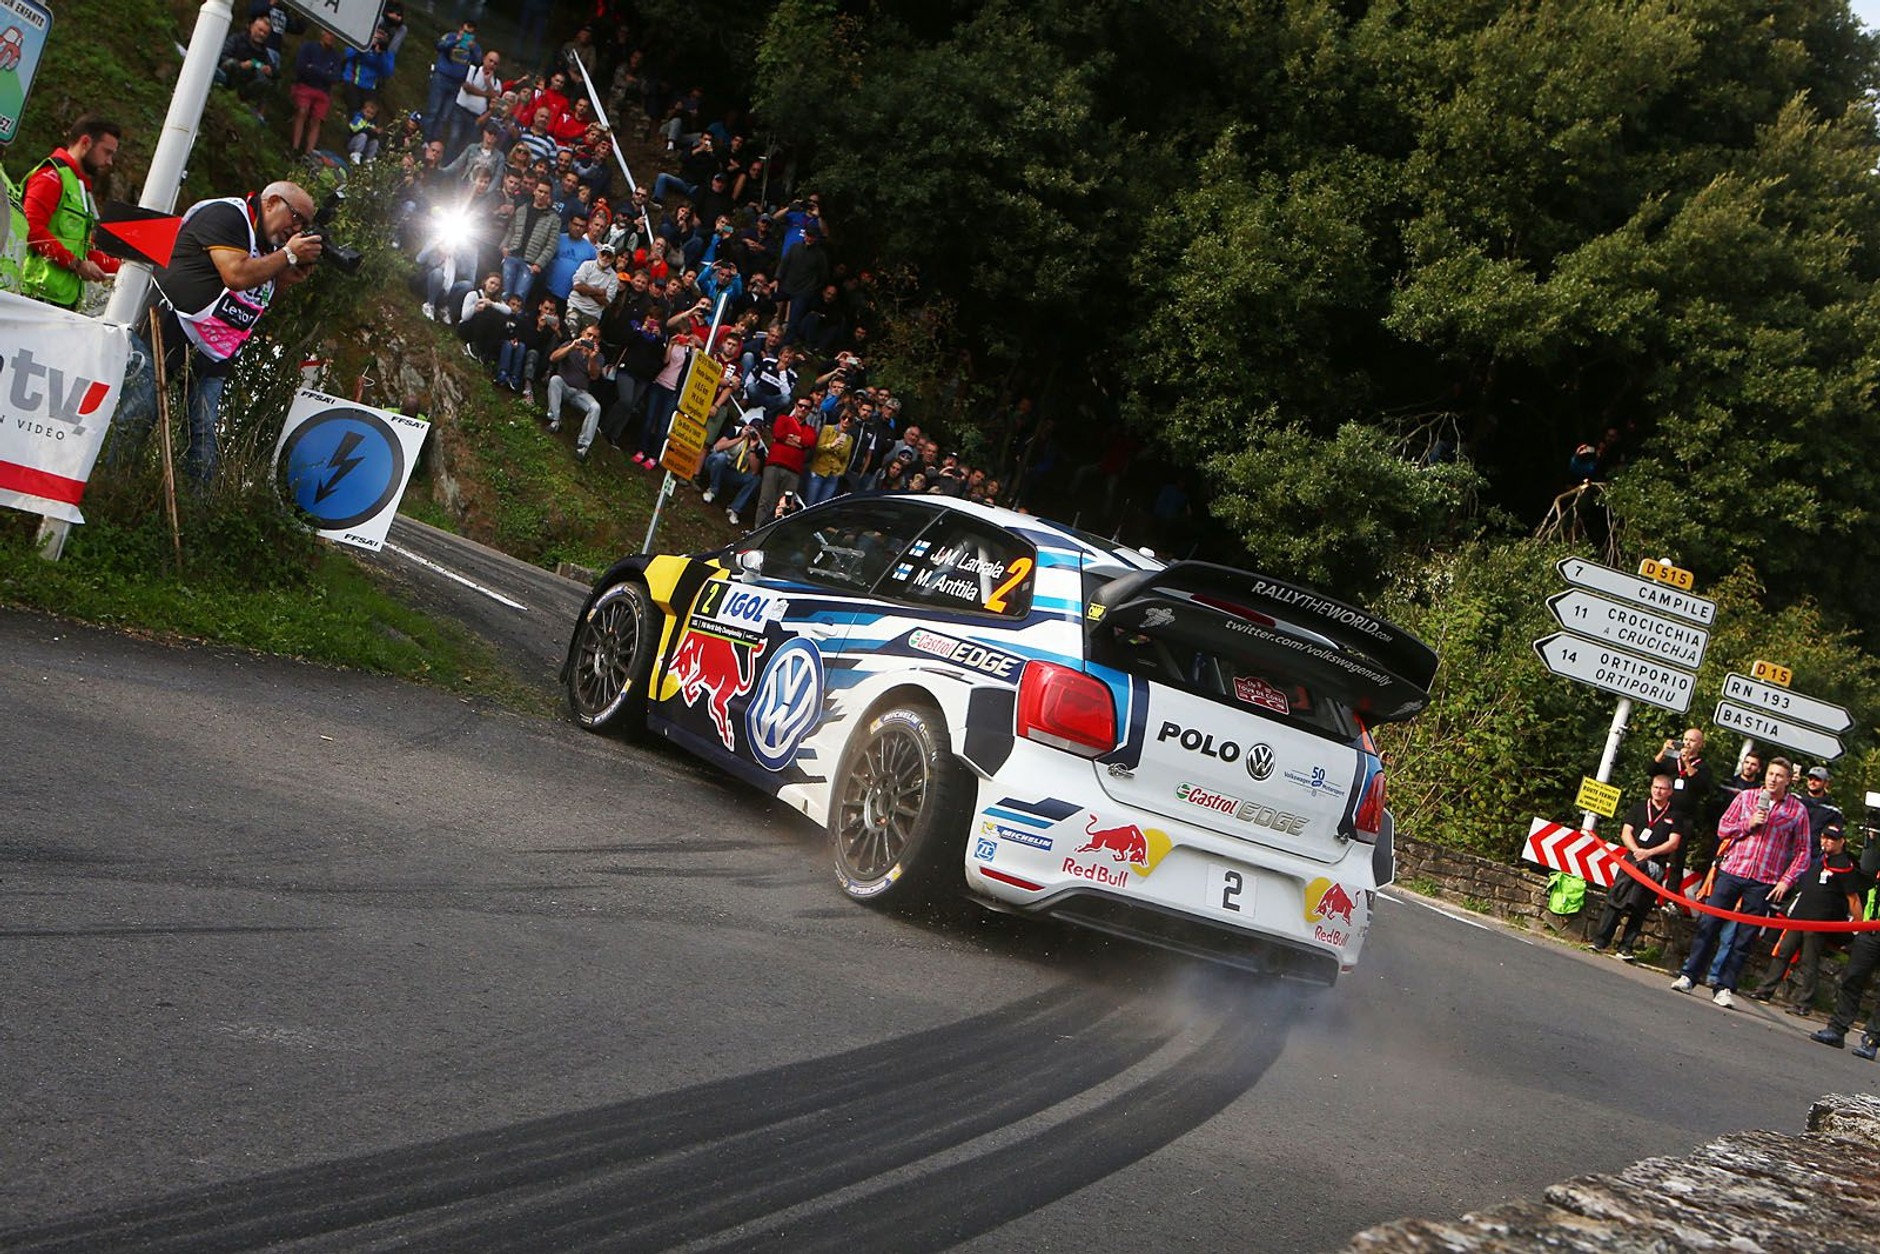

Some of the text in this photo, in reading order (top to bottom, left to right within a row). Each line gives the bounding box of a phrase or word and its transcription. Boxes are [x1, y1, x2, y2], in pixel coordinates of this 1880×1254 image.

[15, 3, 45, 28] ENFANTS
[957, 553, 1005, 579] Latvala
[1575, 566, 1584, 577] 7
[1647, 563, 1688, 585] D 515
[701, 583, 720, 614] 2
[913, 568, 979, 602] M. Anttila
[984, 557, 1032, 613] 2
[723, 591, 770, 622] IGOL
[1574, 605, 1588, 619] 11
[1639, 587, 1710, 619] CAMPILE
[1608, 608, 1700, 647] CROCICCHIA
[917, 635, 1021, 677] Castrol EDGE
[1225, 620, 1393, 687] twitter.com/volkswagenrally
[1562, 649, 1577, 663] 14
[1618, 628, 1697, 662] CRUCICHJA
[1595, 668, 1676, 702] ORTIPORIU
[1600, 653, 1688, 690] ORTIPORIO
[1757, 664, 1788, 682] D 15
[1731, 681, 1790, 709] RN 193
[1723, 709, 1778, 737] BASTIA
[1157, 721, 1241, 763] POLO
[1311, 766, 1326, 781] 50
[1188, 788, 1310, 837] Castrol EDGE
[1001, 829, 1052, 847] MICHELIN
[1062, 857, 1129, 888] Red Bull
[1222, 870, 1243, 912] 2
